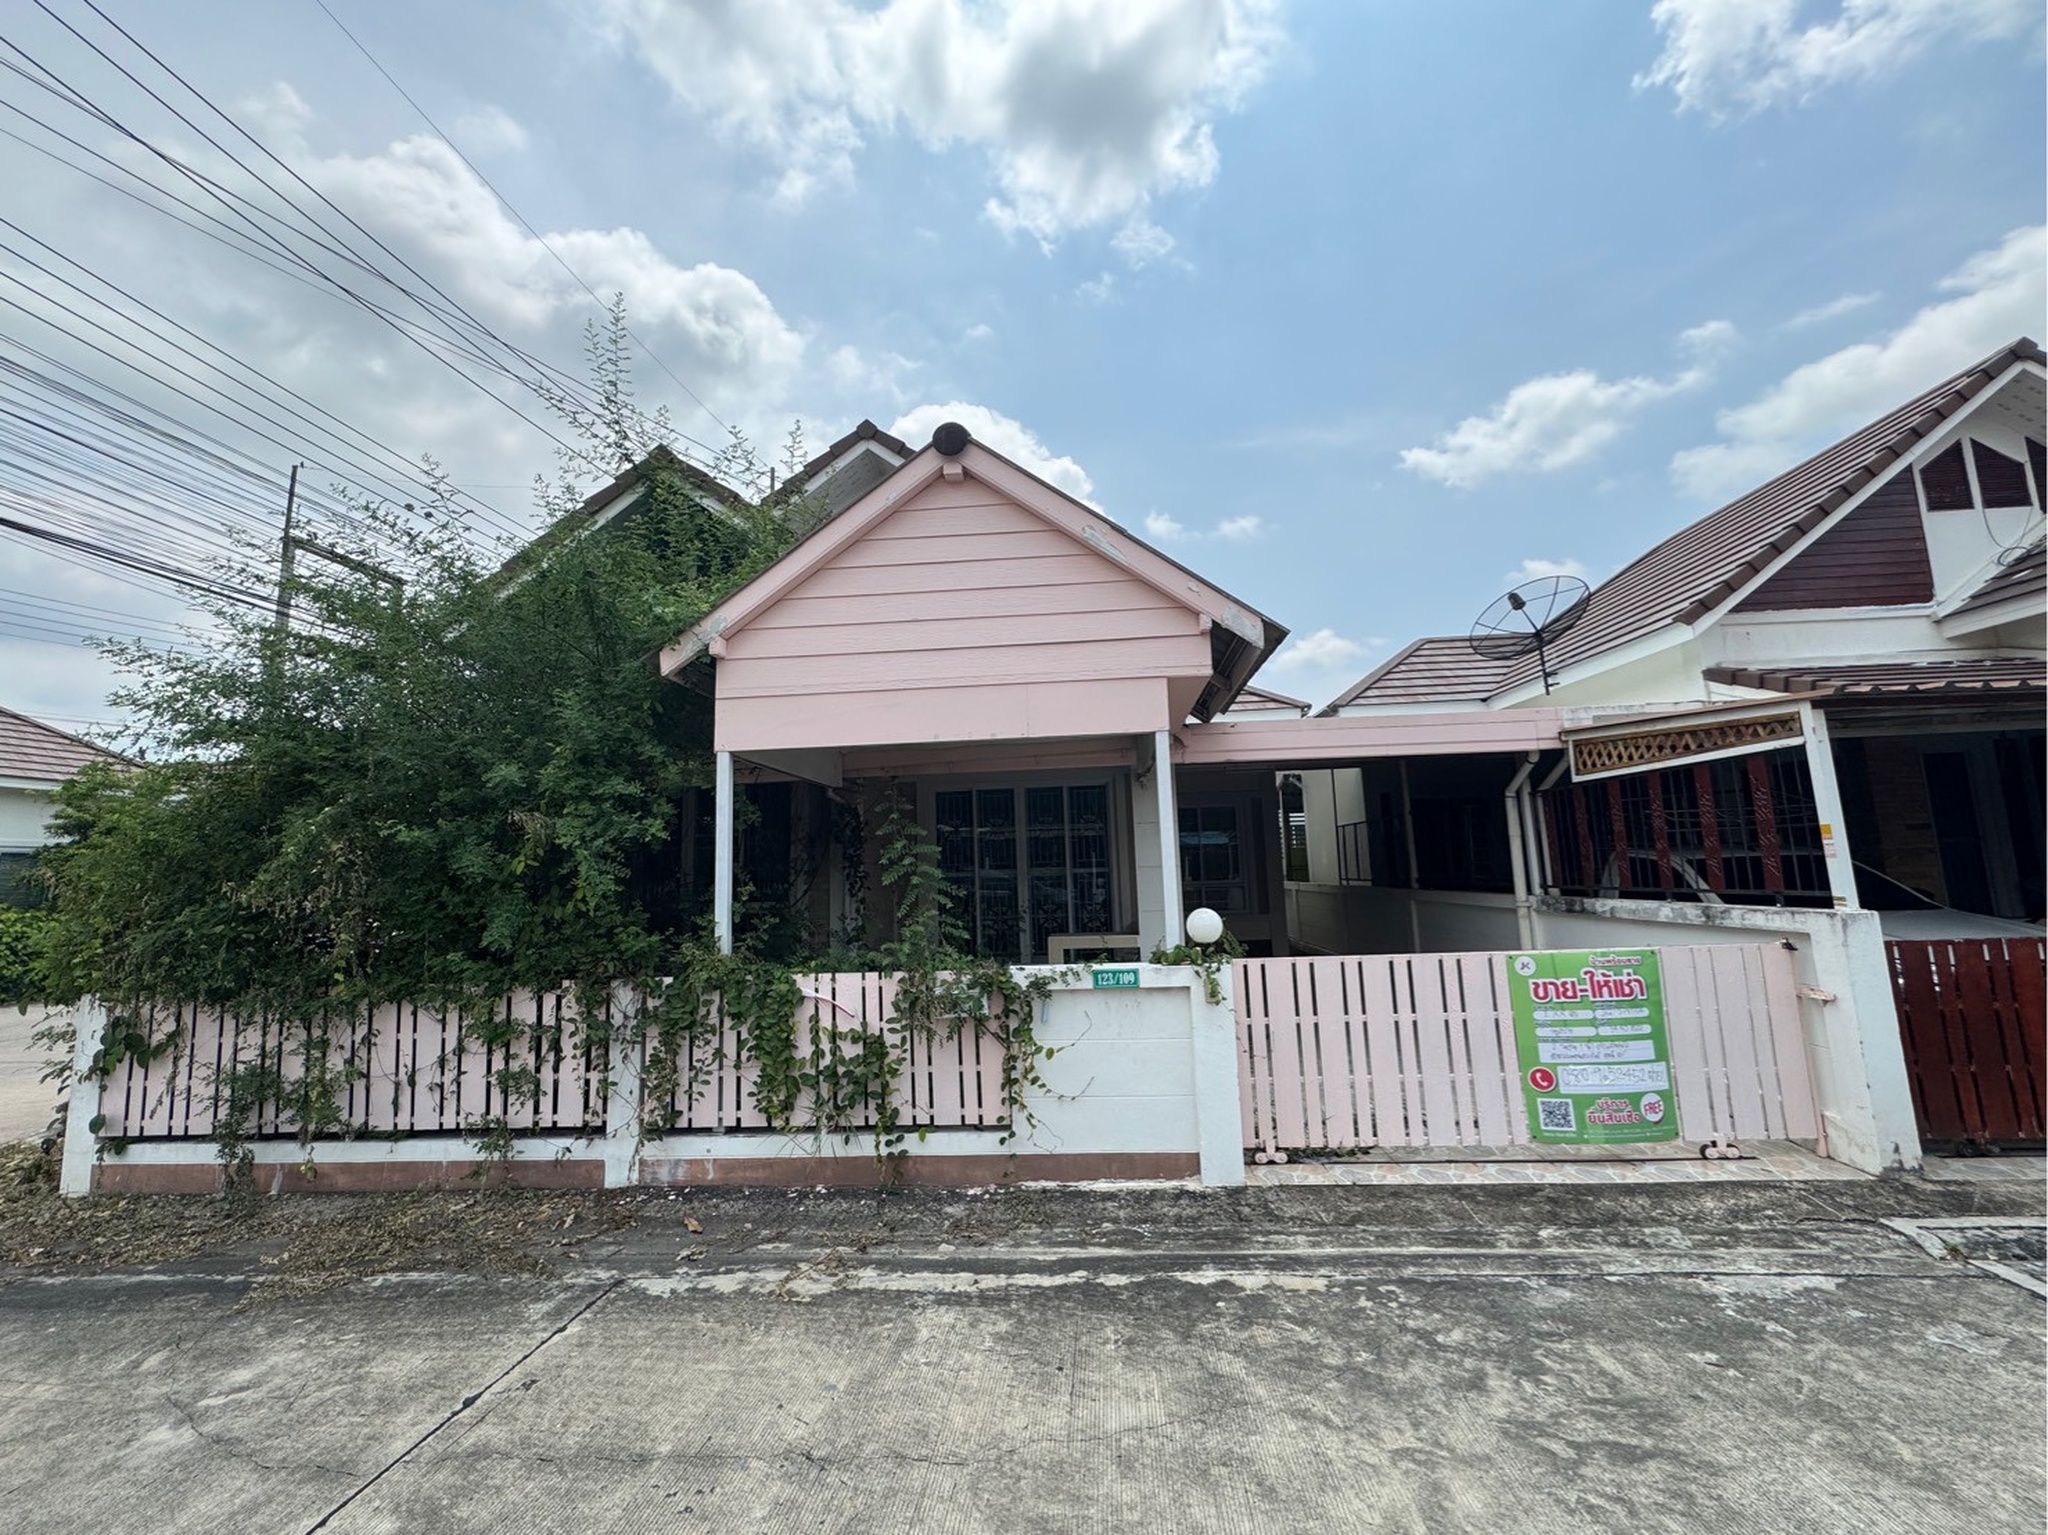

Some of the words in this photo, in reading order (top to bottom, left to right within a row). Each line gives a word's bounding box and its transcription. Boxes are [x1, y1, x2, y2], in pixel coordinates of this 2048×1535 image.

[1098, 972, 1135, 985] 123/109
[1532, 970, 1645, 1000] ขาย-ให้เช่า
[1596, 1098, 1629, 1109] บริการ
[1643, 1100, 1663, 1116] FREE
